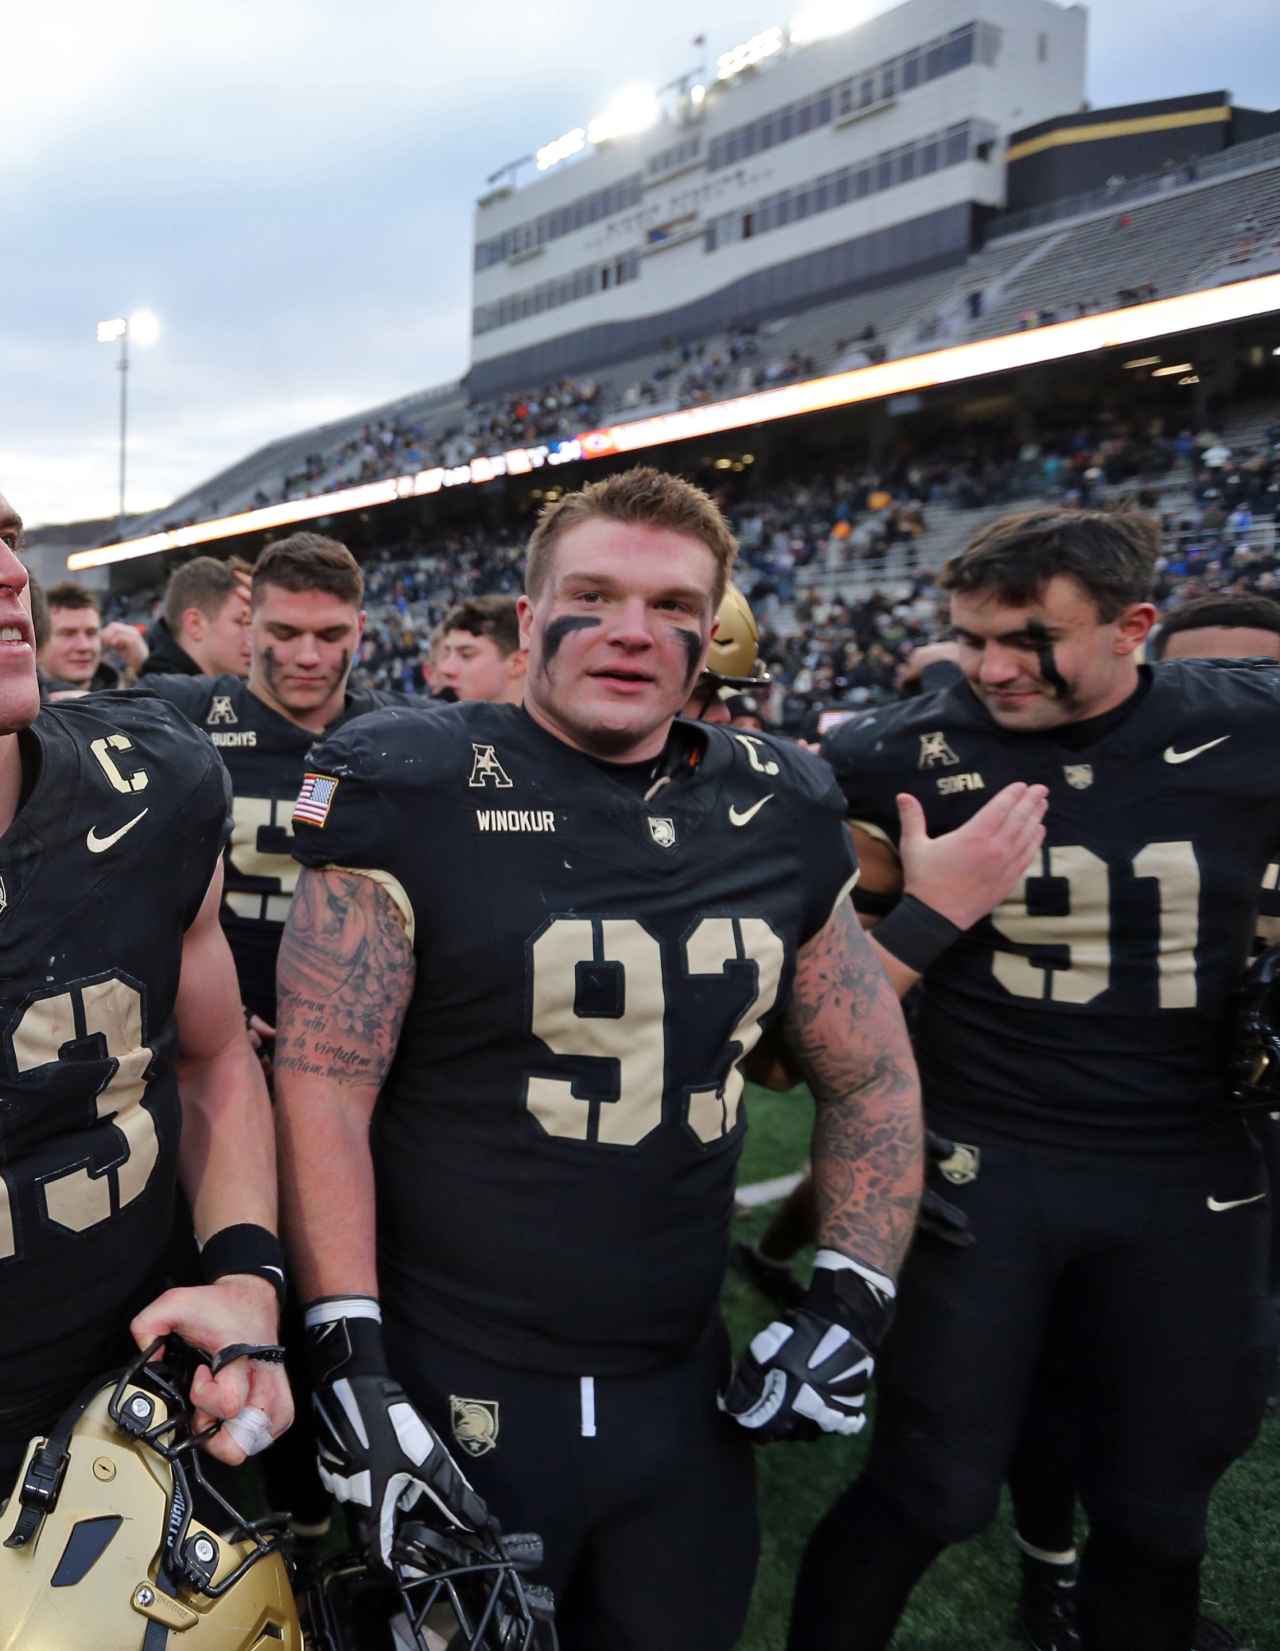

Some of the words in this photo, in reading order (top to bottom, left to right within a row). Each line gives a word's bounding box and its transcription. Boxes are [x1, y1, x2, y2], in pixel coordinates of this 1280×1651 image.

[89, 733, 150, 795] C
[936, 771, 985, 796] SOFIA
[476, 809, 556, 833] WINOKUR
[991, 840, 1201, 1009] 91
[526, 918, 785, 1146] 93
